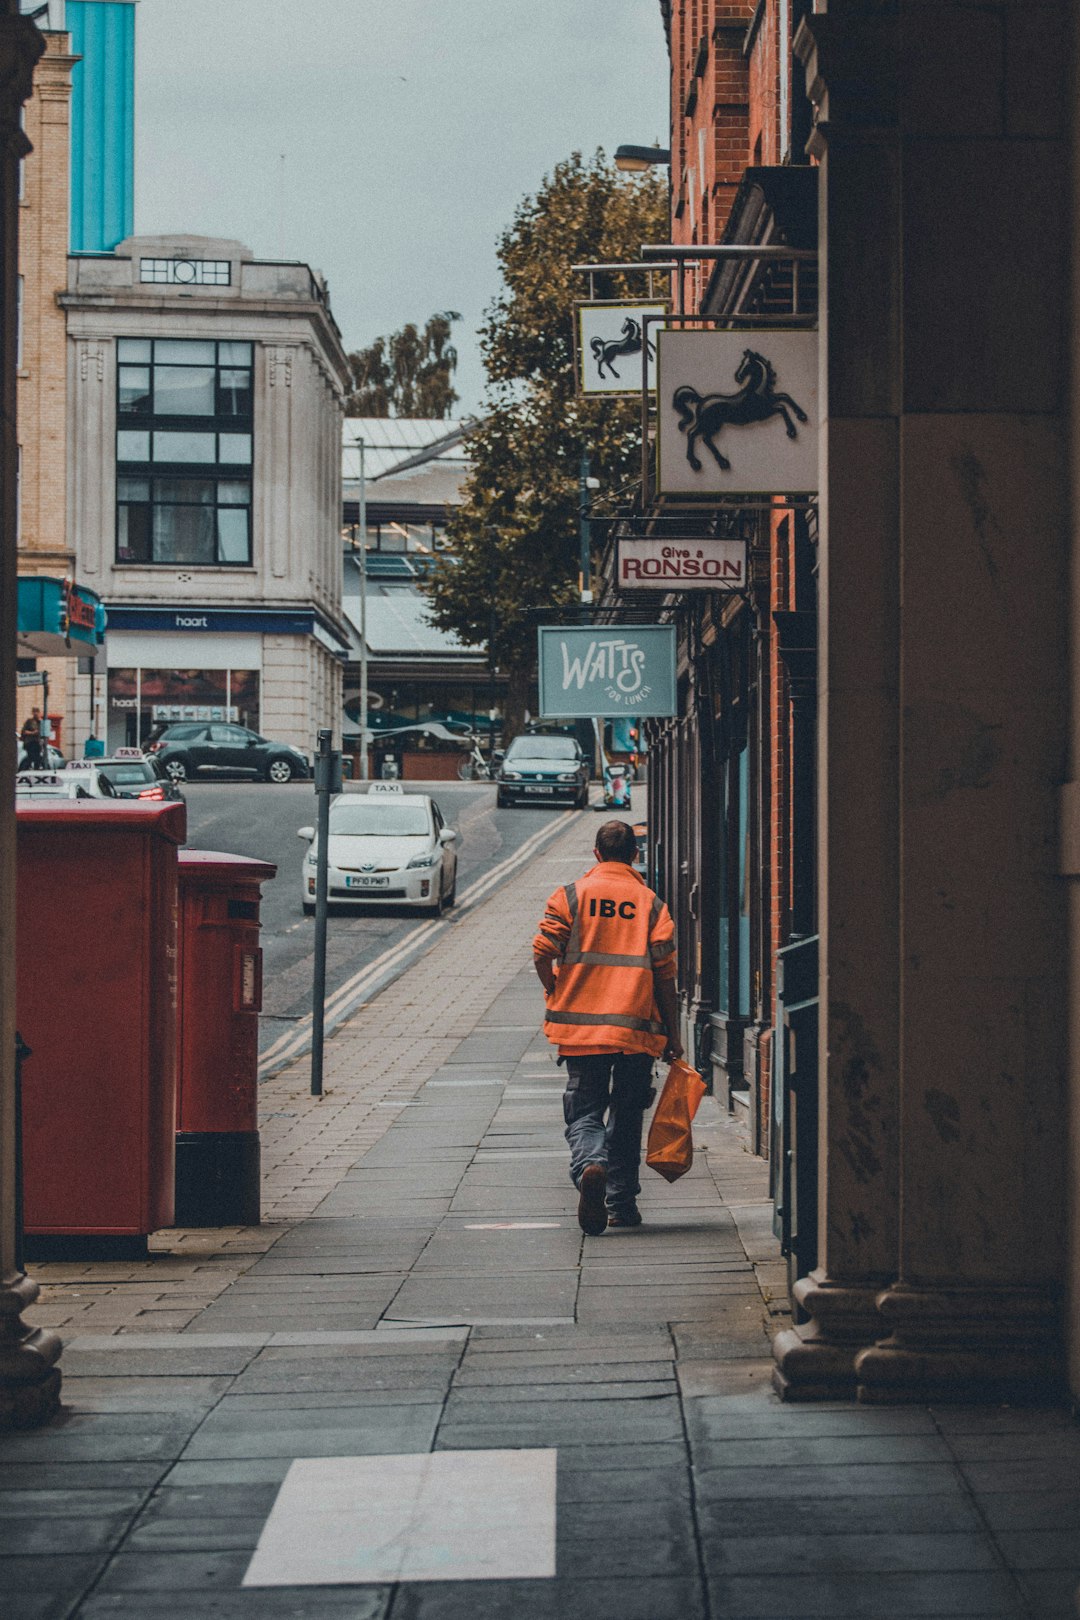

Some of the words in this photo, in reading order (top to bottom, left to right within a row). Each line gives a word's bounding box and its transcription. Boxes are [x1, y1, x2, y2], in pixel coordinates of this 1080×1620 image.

[661, 547, 690, 558] Give
[696, 549, 703, 558] a
[623, 558, 741, 579] RONSON
[175, 615, 208, 627] haart
[605, 685, 622, 703] FOR
[624, 685, 653, 705] LUNCH
[119, 749, 139, 757] TAXI
[16, 776, 57, 784] AXI
[373, 784, 399, 792] TAXI
[589, 898, 637, 920] IBC
